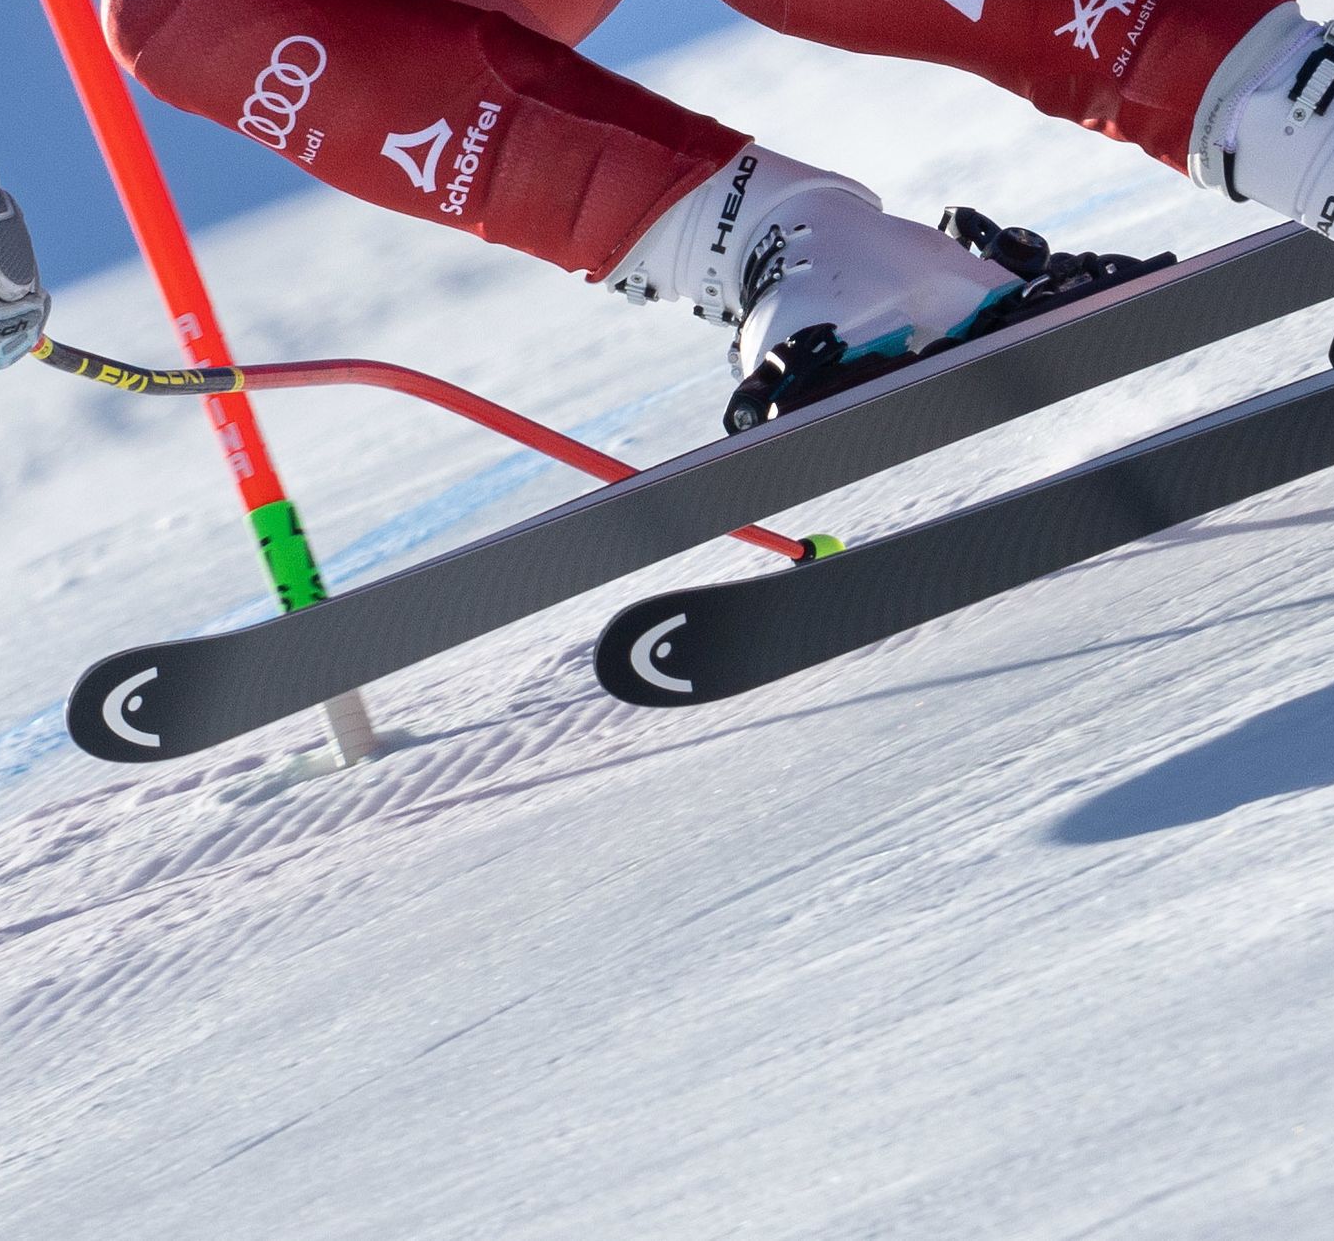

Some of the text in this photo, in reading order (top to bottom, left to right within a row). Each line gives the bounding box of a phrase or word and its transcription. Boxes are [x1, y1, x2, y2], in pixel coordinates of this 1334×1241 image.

[1111, 46, 1132, 78] Ski
[298, 128, 325, 165] Audi
[710, 155, 759, 255] HEAD
